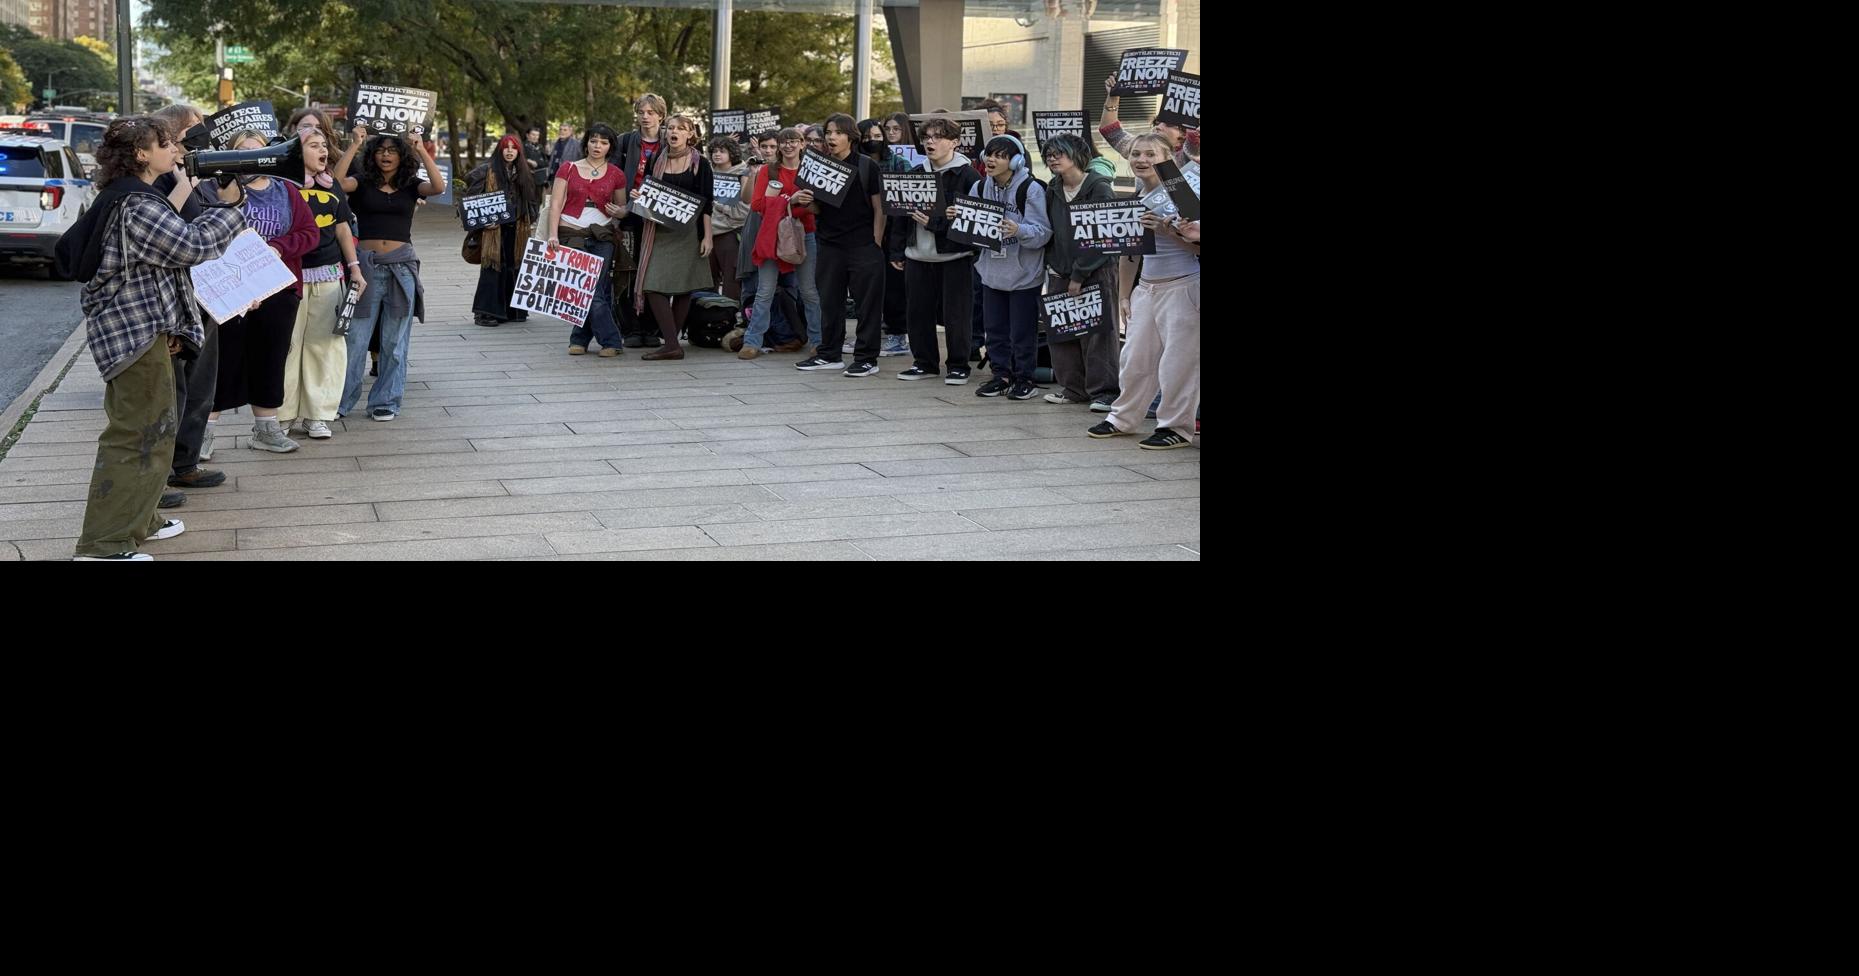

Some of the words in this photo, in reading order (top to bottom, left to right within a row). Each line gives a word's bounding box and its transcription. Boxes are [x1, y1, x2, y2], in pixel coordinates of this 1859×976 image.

[1120, 57, 1179, 70] FREEZE
[1118, 69, 1132, 81] AI
[1135, 68, 1169, 80] NOW
[357, 90, 429, 111] FREEZE
[1166, 82, 1200, 104] FREE
[214, 114, 231, 127] BIG
[231, 106, 261, 118] TECH
[356, 104, 376, 118] AI
[380, 106, 426, 124] NOW
[1164, 98, 1180, 113] AI
[1182, 101, 1200, 118] NO
[210, 114, 273, 139] BILLIONAIRES
[246, 122, 270, 130] OWN
[712, 115, 745, 126] FREEZE
[713, 125, 722, 134] AI
[724, 123, 744, 133] NOW
[1036, 118, 1083, 129] FREEZE
[1039, 130, 1046, 140] AI
[801, 154, 849, 186] FREEZE
[714, 180, 741, 190] EEZE
[798, 166, 808, 180] AI
[806, 172, 843, 195] NOW
[883, 180, 937, 191] FREEZE
[463, 194, 506, 210] FREEZE
[639, 184, 699, 215] FREEZE
[886, 191, 899, 202] AI
[902, 191, 936, 202] NOW
[468, 209, 479, 219] AI
[480, 203, 506, 216] NOW
[633, 195, 652, 208] AI
[653, 202, 692, 224] NOW
[955, 204, 1003, 227] FREE
[1070, 207, 1146, 226] FREEZE
[952, 218, 969, 232] AI
[973, 223, 1002, 241] NO
[1074, 225, 1093, 240] AI
[1098, 222, 1144, 238] NOW
[528, 239, 544, 256] I
[524, 259, 565, 280] THAT
[565, 268, 581, 284] IT
[517, 274, 533, 290] IS
[532, 278, 557, 297] AN
[556, 284, 593, 309] INSULT
[515, 290, 536, 308] TO
[535, 295, 559, 315] LIFE
[1045, 290, 1102, 315] FREEZE
[1051, 312, 1066, 327] AI
[1069, 303, 1102, 323] NOW
